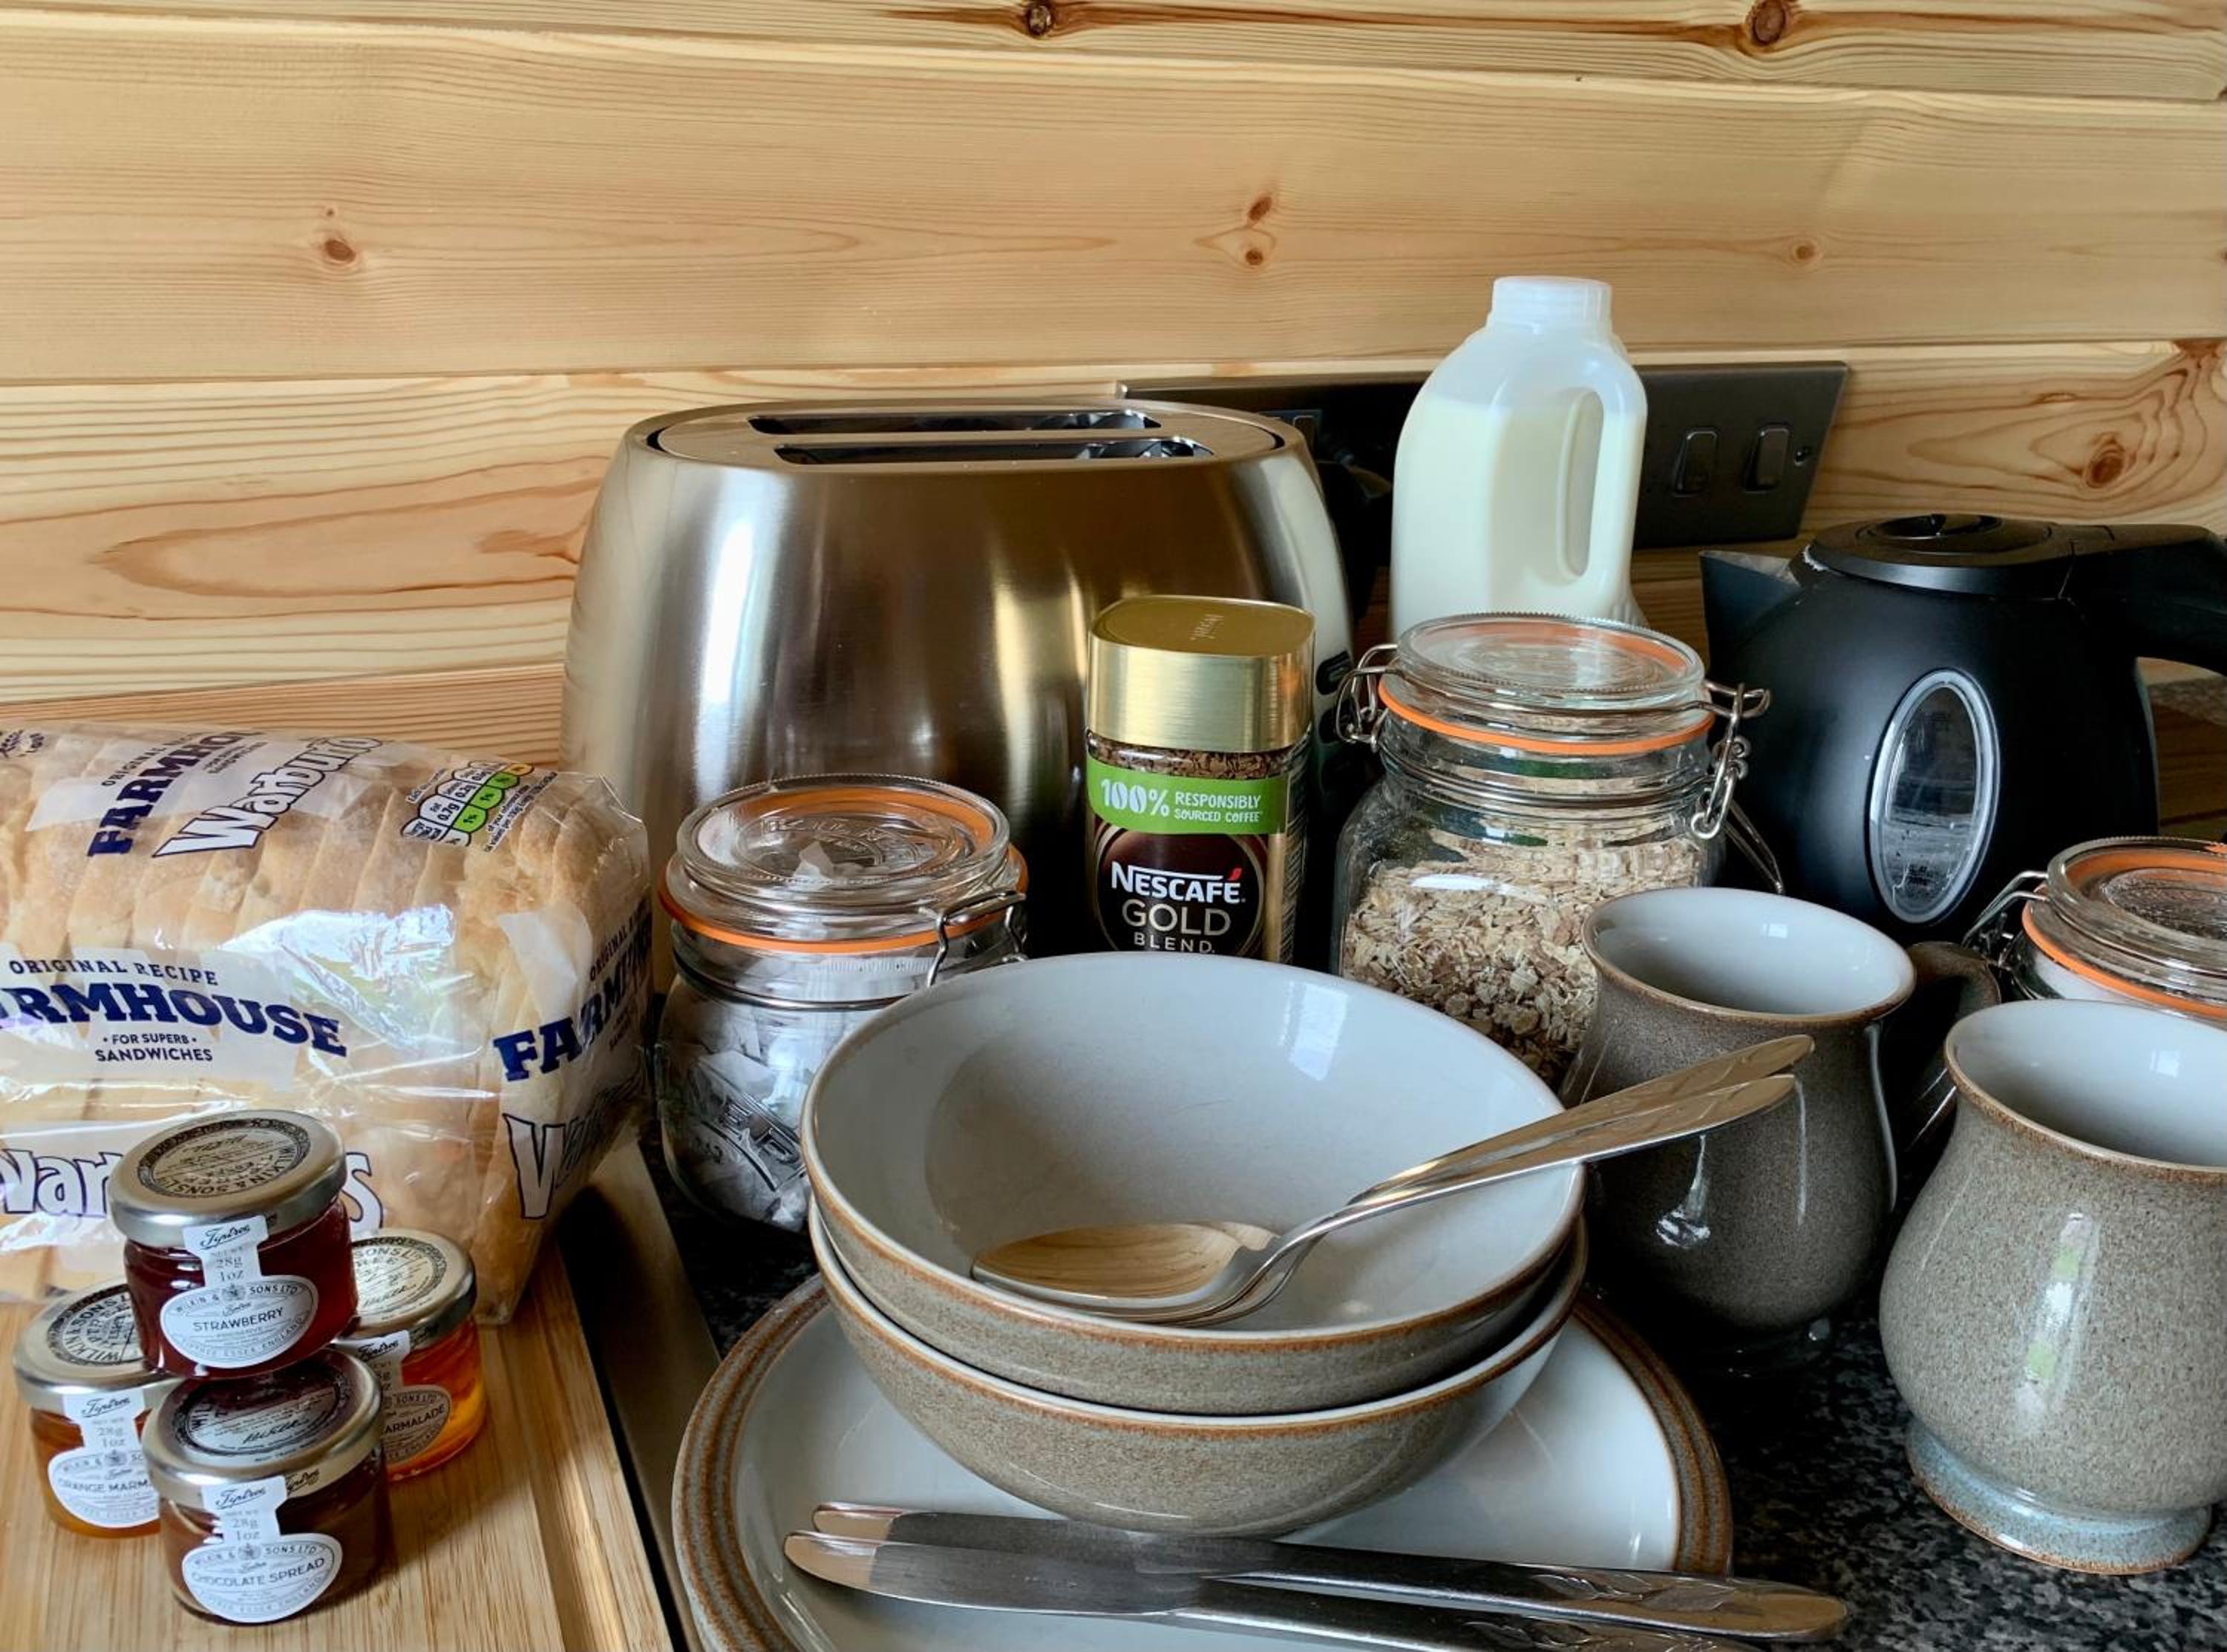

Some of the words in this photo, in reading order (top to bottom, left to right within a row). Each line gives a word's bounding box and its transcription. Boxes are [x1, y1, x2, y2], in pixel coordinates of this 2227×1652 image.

[1101, 778, 1170, 817] 100%
[1175, 791, 1261, 810] RESPONSIBLY
[437, 802, 460, 822] 0.7g
[1174, 808, 1221, 822] SOURCED
[1225, 811, 1260, 823] COFFEE
[1122, 898, 1232, 937] GOLD
[1134, 932, 1213, 954] BLEND
[9, 959, 128, 974] ORIGINAL
[137, 962, 218, 986] RECIPE
[0, 983, 347, 1058] RMHOUSE
[111, 1034, 140, 1046] FOR
[141, 1033, 189, 1046] SUPERB
[95, 1049, 214, 1063] SANDWICHES
[249, 1284, 278, 1295] SONS
[192, 1307, 284, 1332] STRAWBERRY
[381, 1403, 446, 1435] ARMALADE
[109, 1478, 148, 1492] MARM
[264, 1547, 295, 1556] SONS
[192, 1572, 266, 1587] CHOCOLATE
[269, 1558, 325, 1583] SPREAD
